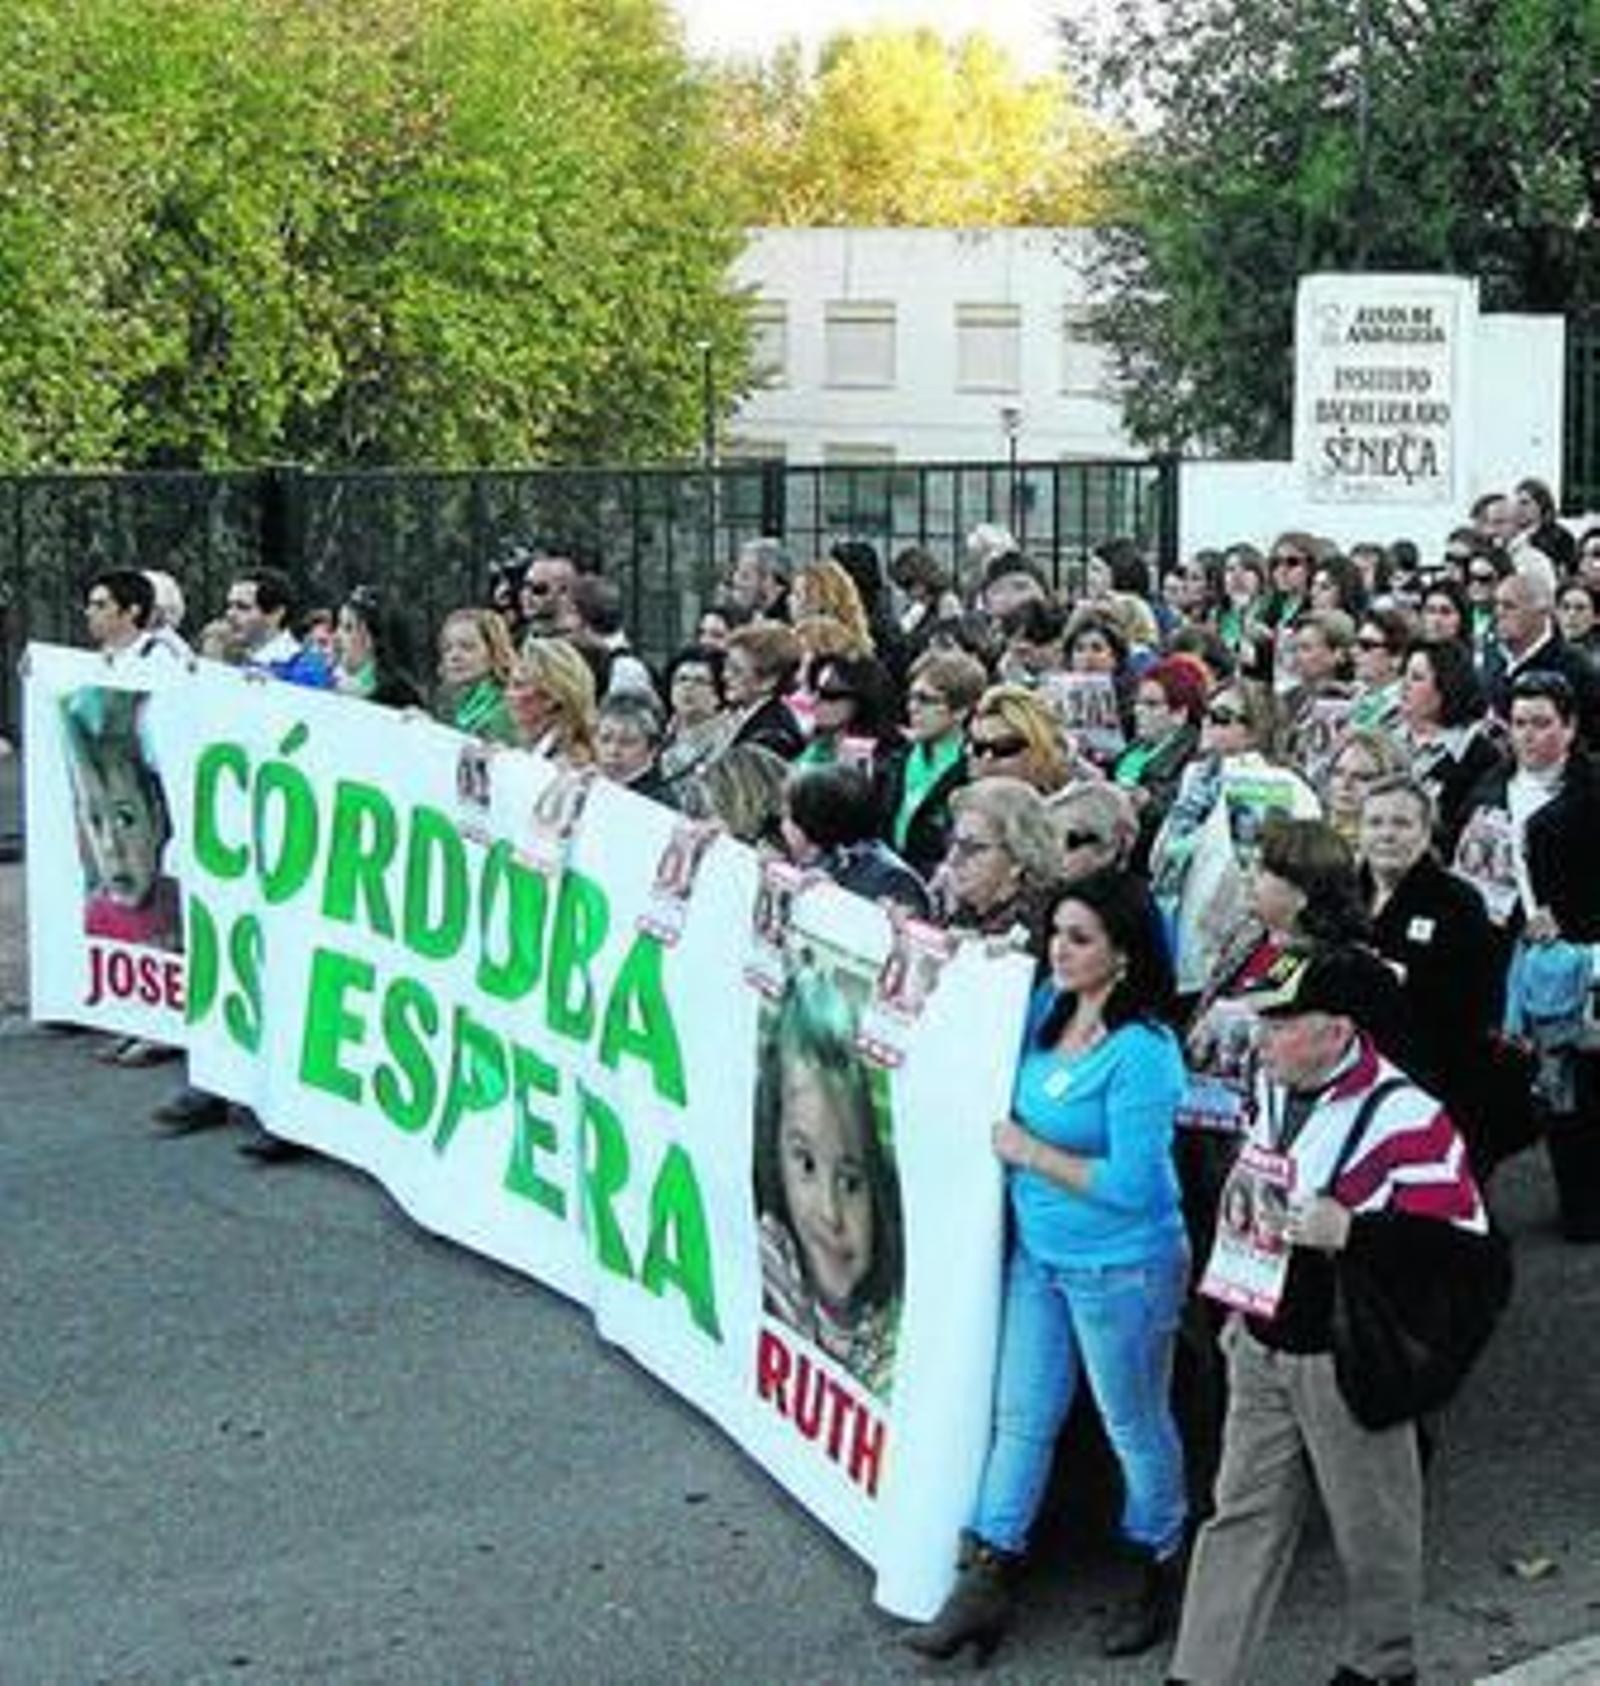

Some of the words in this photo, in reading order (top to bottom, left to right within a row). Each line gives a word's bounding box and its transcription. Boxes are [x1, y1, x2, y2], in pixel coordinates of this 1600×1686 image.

[86, 946, 185, 1012] JOSE
[193, 722, 687, 1108] CÓRDOBA
[301, 947, 722, 1343] ESPERA
[757, 1328, 885, 1500] RUTH
